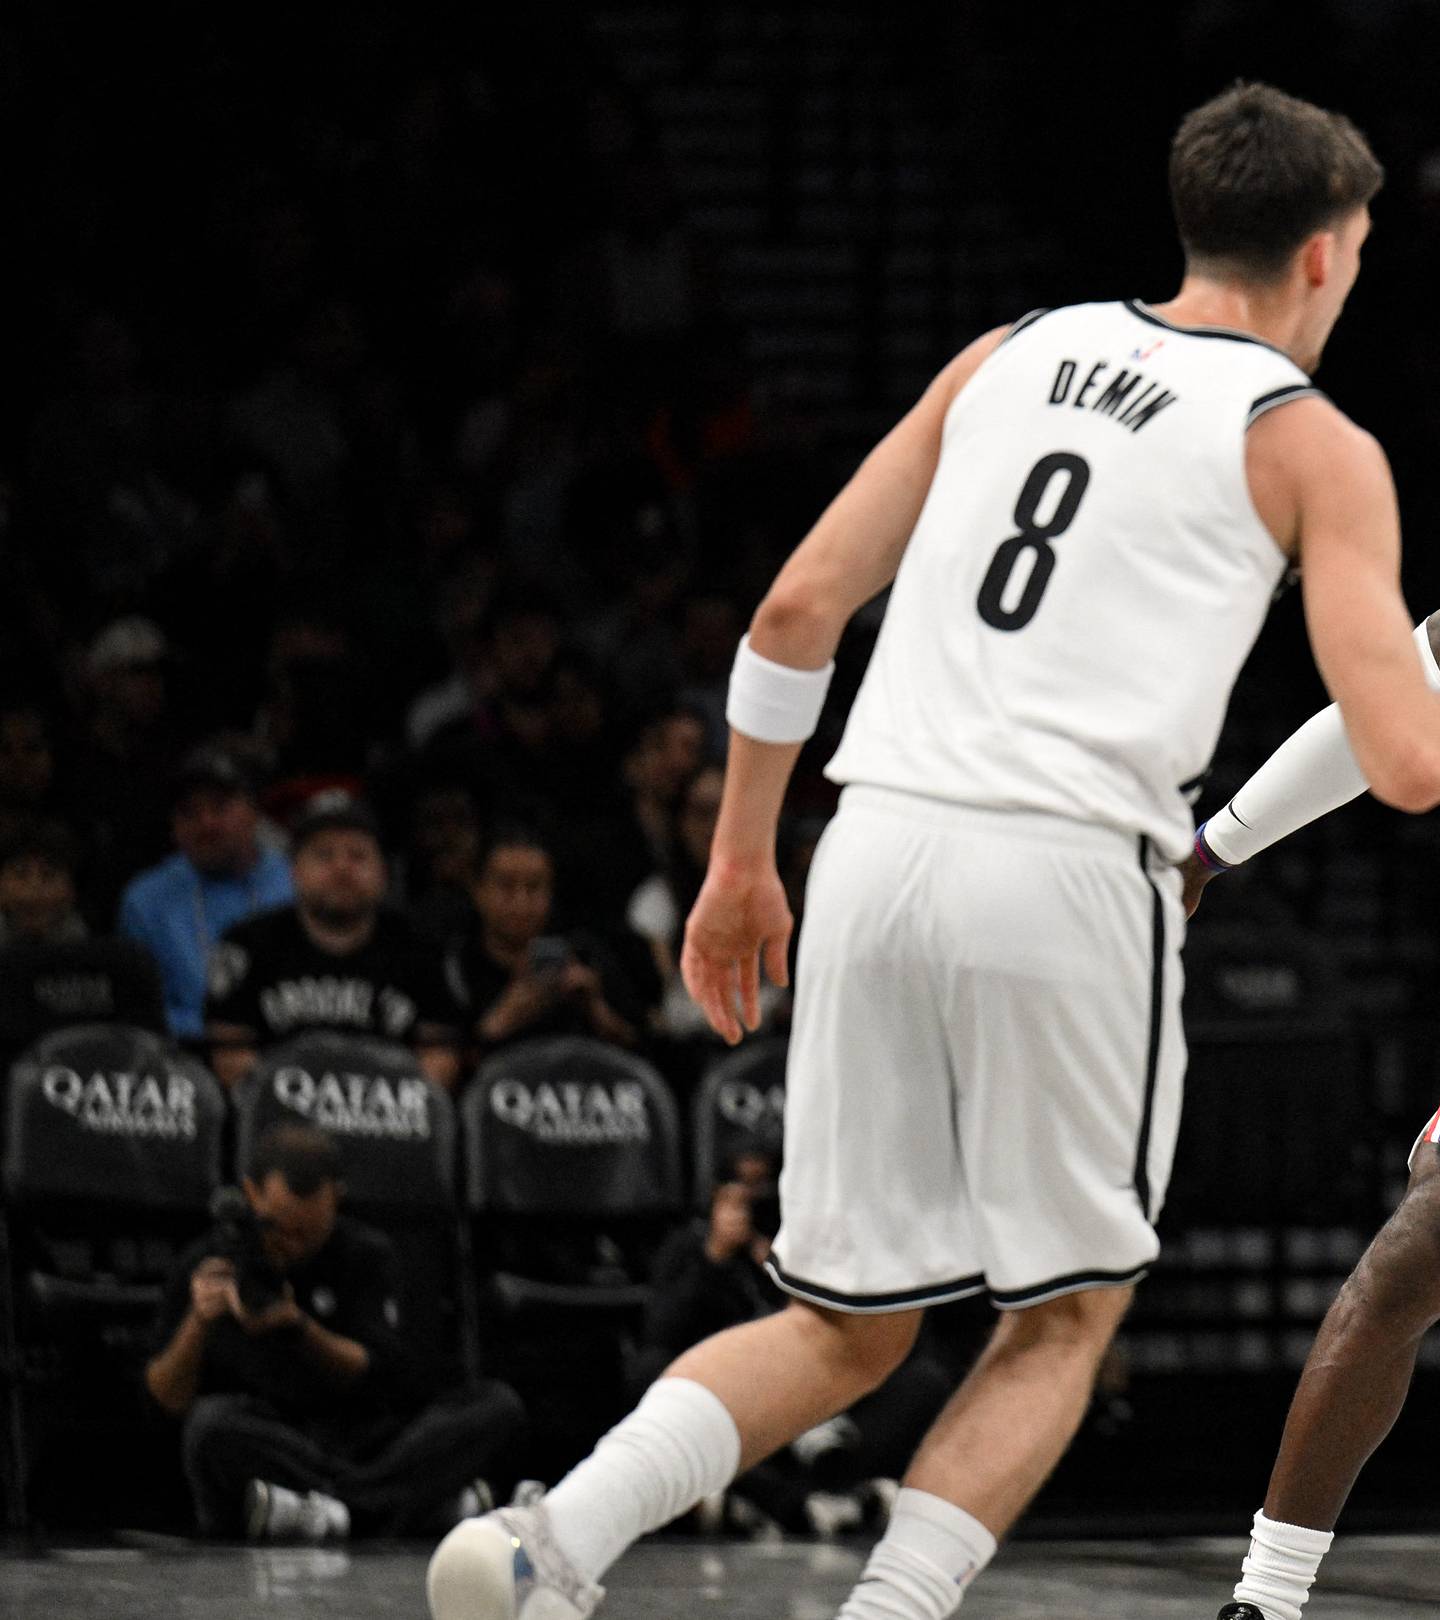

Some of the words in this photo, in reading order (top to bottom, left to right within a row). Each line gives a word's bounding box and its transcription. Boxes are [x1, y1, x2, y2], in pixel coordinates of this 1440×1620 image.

[976, 452, 1091, 632] 8
[42, 1065, 197, 1118] QATAR
[273, 1065, 429, 1118] QATAR
[490, 1078, 645, 1125] QATAR
